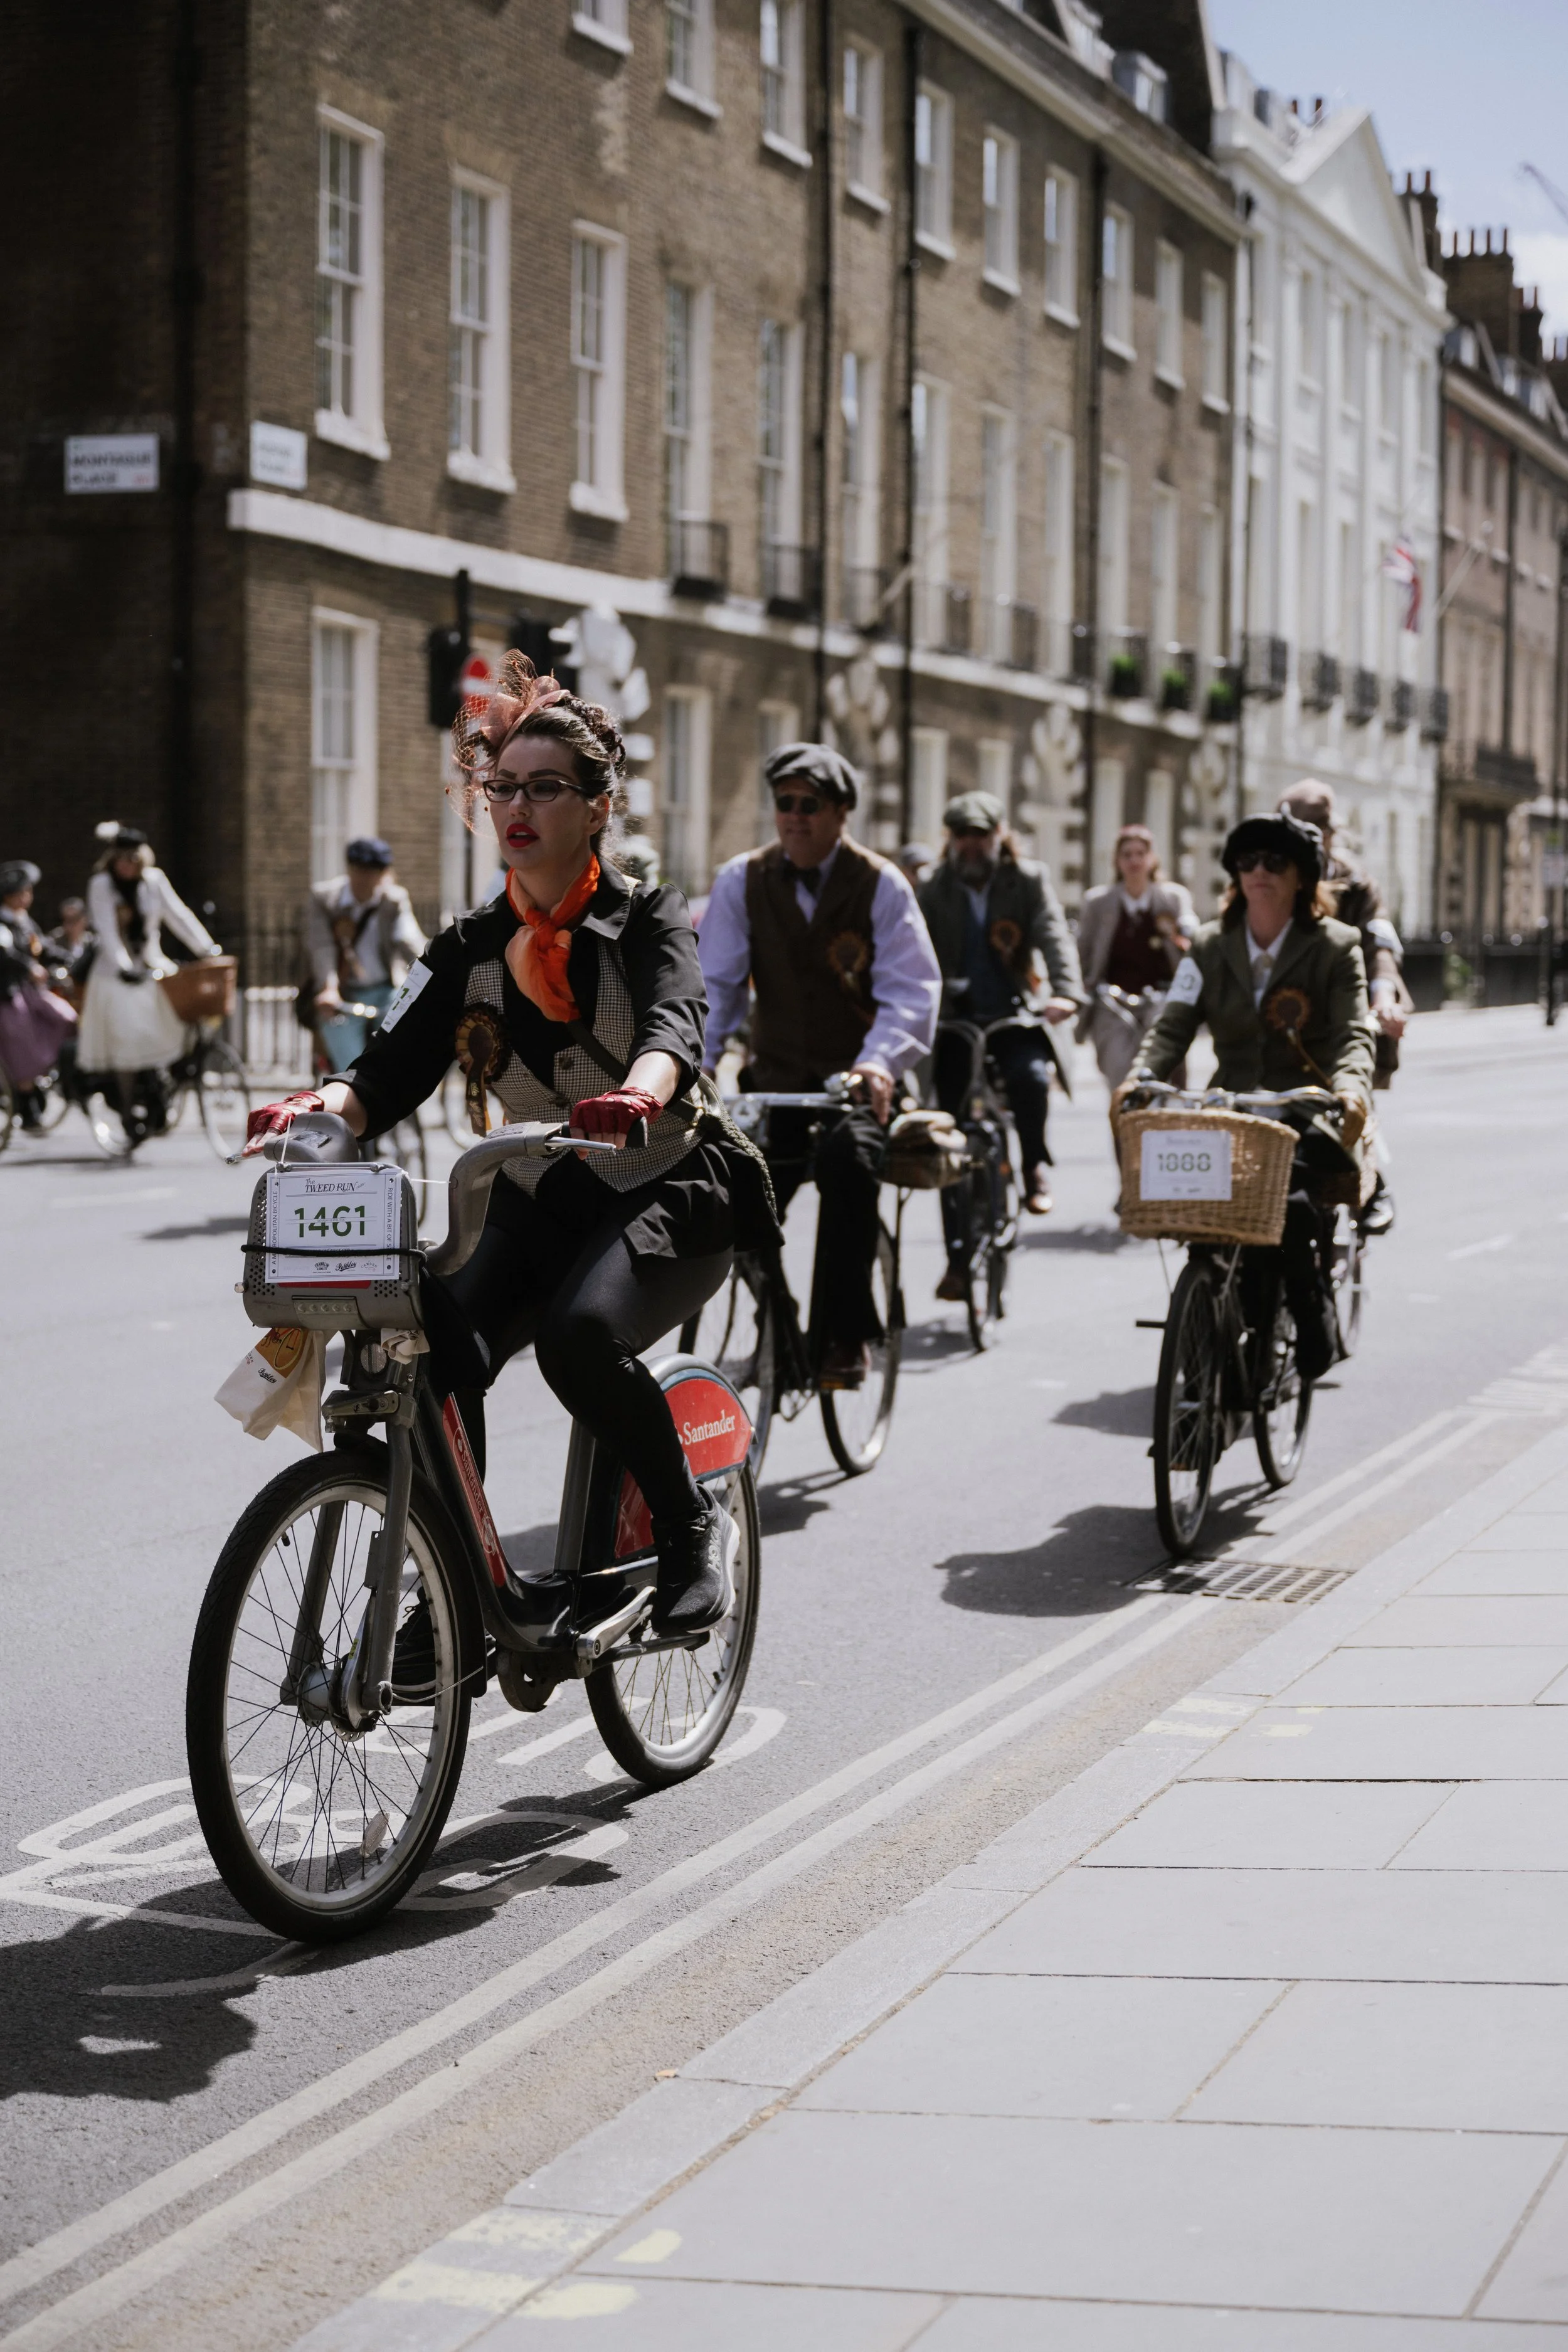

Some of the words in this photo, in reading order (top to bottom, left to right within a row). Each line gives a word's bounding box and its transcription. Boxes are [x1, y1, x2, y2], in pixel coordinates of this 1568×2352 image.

[1157, 1153, 1211, 1172] 1888
[305, 1184, 335, 1193] TWEED
[337, 1182, 359, 1192] RUN
[294, 1205, 366, 1237] 1461
[386, 1234, 392, 1242] OF
[683, 1409, 736, 1445] Santander
[460, 1449, 484, 1517] Santander
